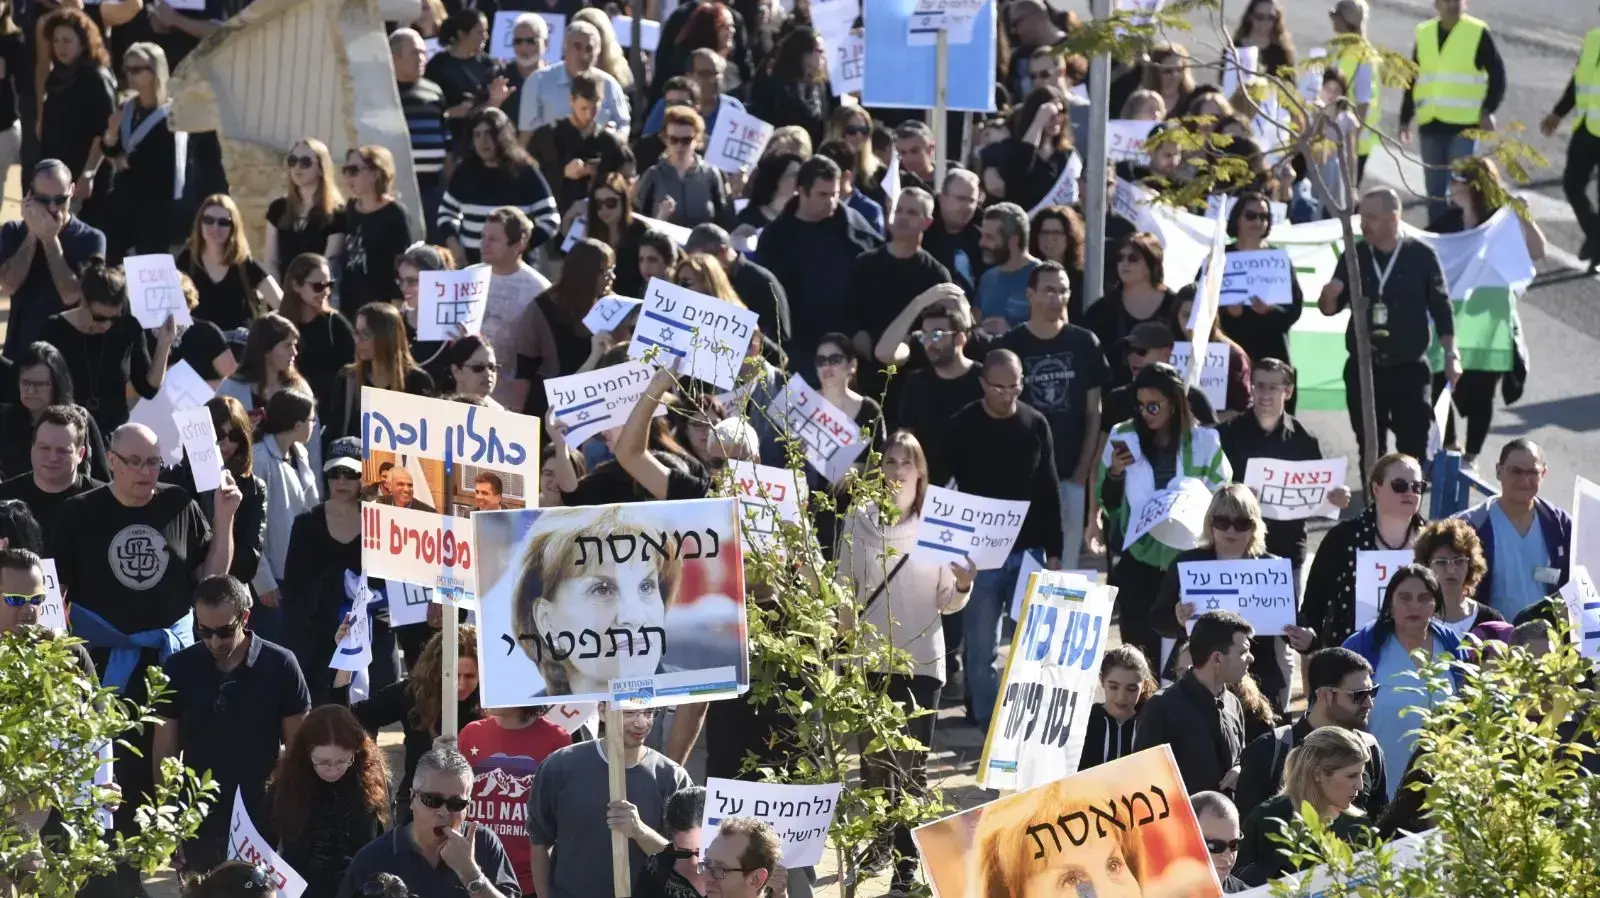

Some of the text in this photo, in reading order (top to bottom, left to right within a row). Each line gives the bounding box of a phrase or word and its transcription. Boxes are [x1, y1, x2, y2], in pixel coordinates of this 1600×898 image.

[435, 281, 445, 297] ל
[655, 289, 676, 313] על
[683, 305, 748, 339] נלחמים
[690, 336, 740, 360] ירושלים
[553, 369, 650, 406] נלחמים על
[797, 392, 808, 406] ל
[362, 406, 527, 466] כחלון וכהן
[1263, 467, 1332, 487] כצאן ל
[933, 497, 1022, 527] נלחמים על
[389, 518, 471, 570] מפוטרים
[574, 527, 720, 566] נמאסת
[970, 535, 1014, 548] ירושלים
[1187, 568, 1288, 586] נלחמים על
[1239, 593, 1291, 608] ירושלים
[501, 626, 667, 664] תתפטרי
[1058, 611, 1102, 671] נטו
[1041, 688, 1078, 748] נטו
[467, 800, 495, 820] OLD
[716, 790, 832, 817] נלחמים על
[777, 827, 826, 843] ירושלי
[1025, 785, 1170, 860] נמאסת
